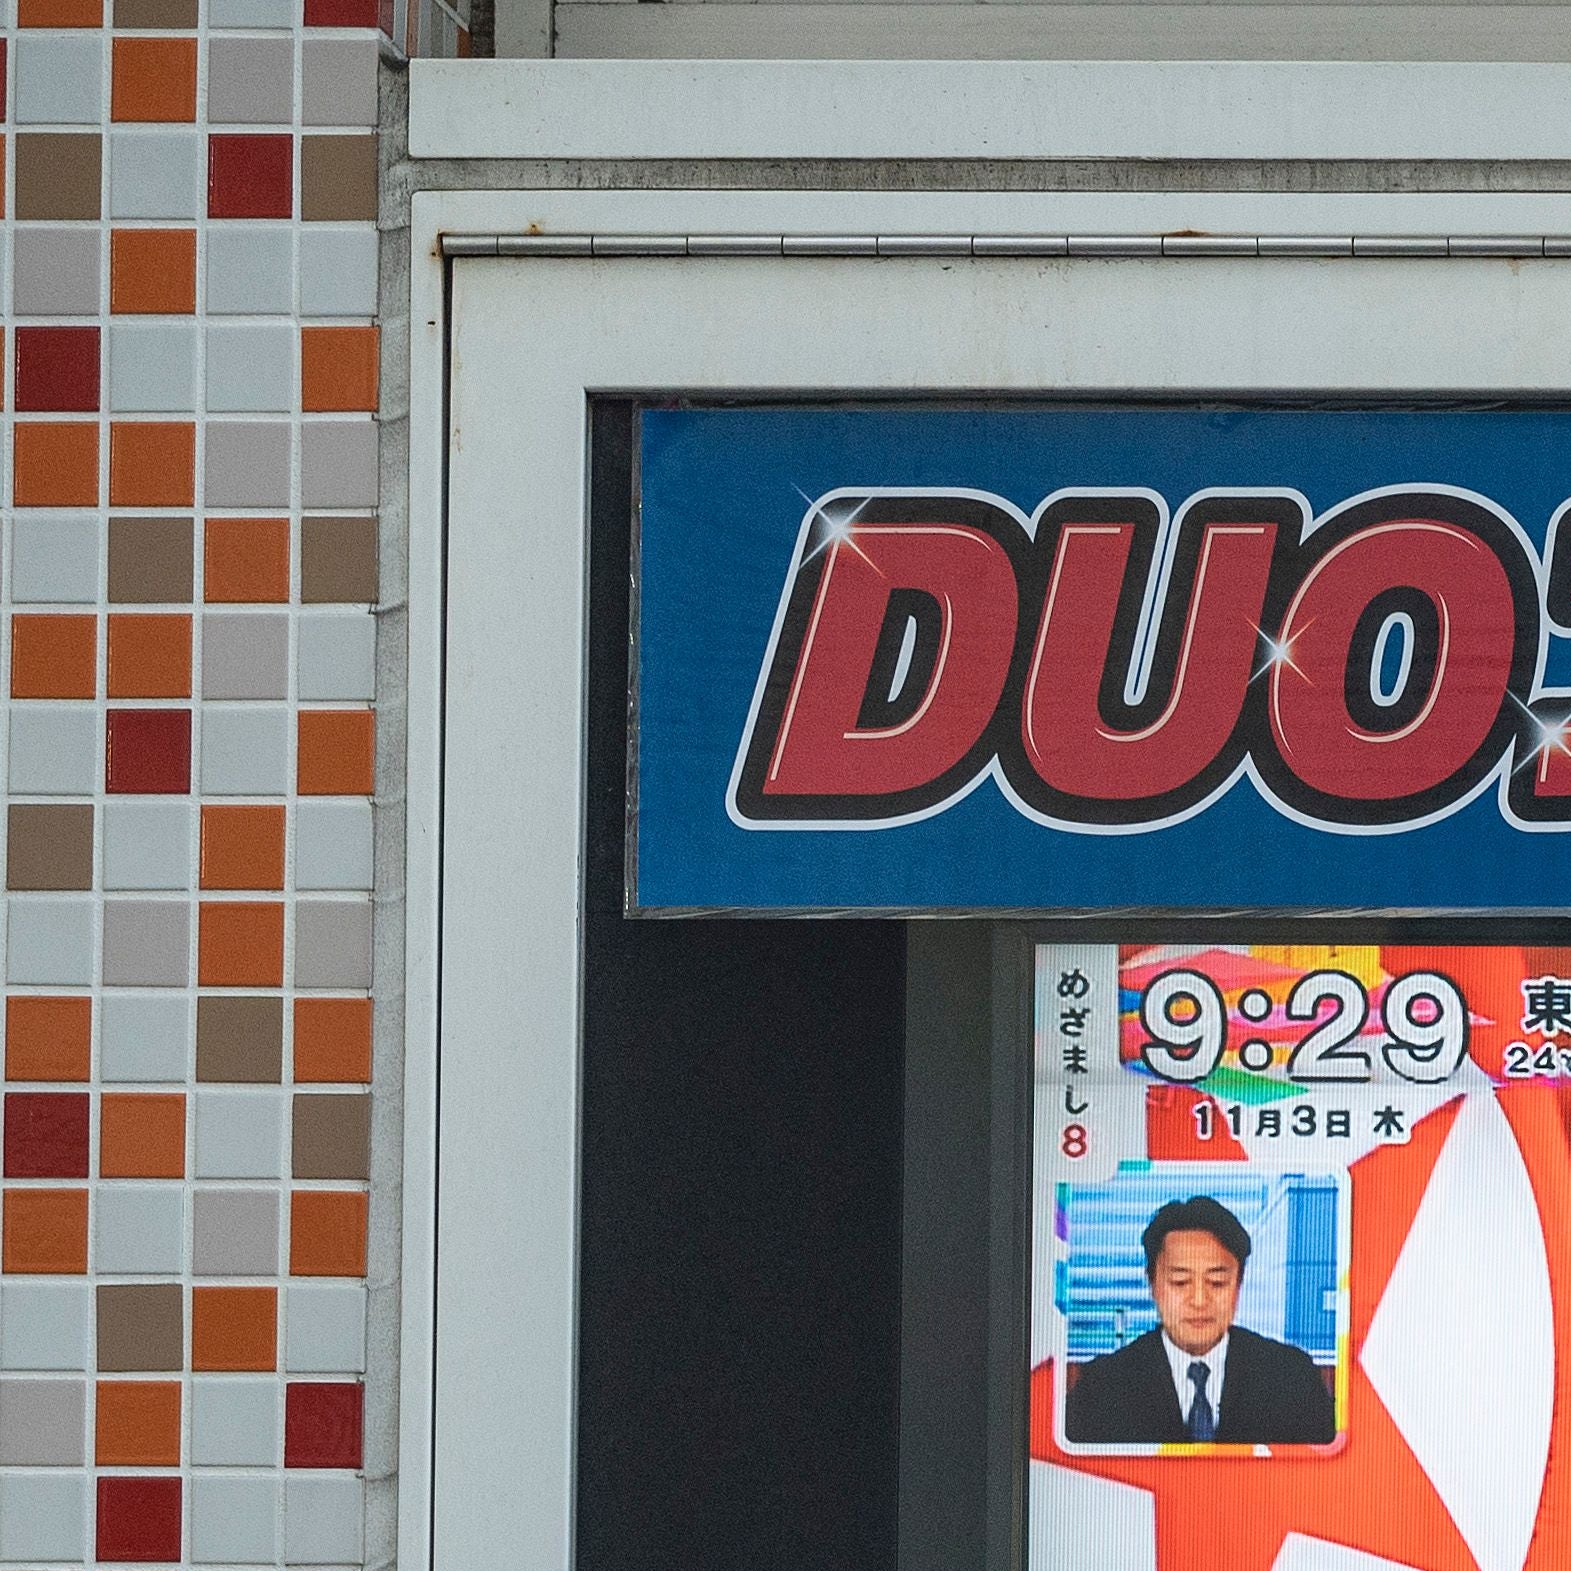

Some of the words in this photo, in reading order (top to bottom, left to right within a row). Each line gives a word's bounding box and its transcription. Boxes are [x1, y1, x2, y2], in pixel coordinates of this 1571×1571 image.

[1057, 969, 1091, 1157] めざまし8
[1140, 969, 1470, 1083] 9:29
